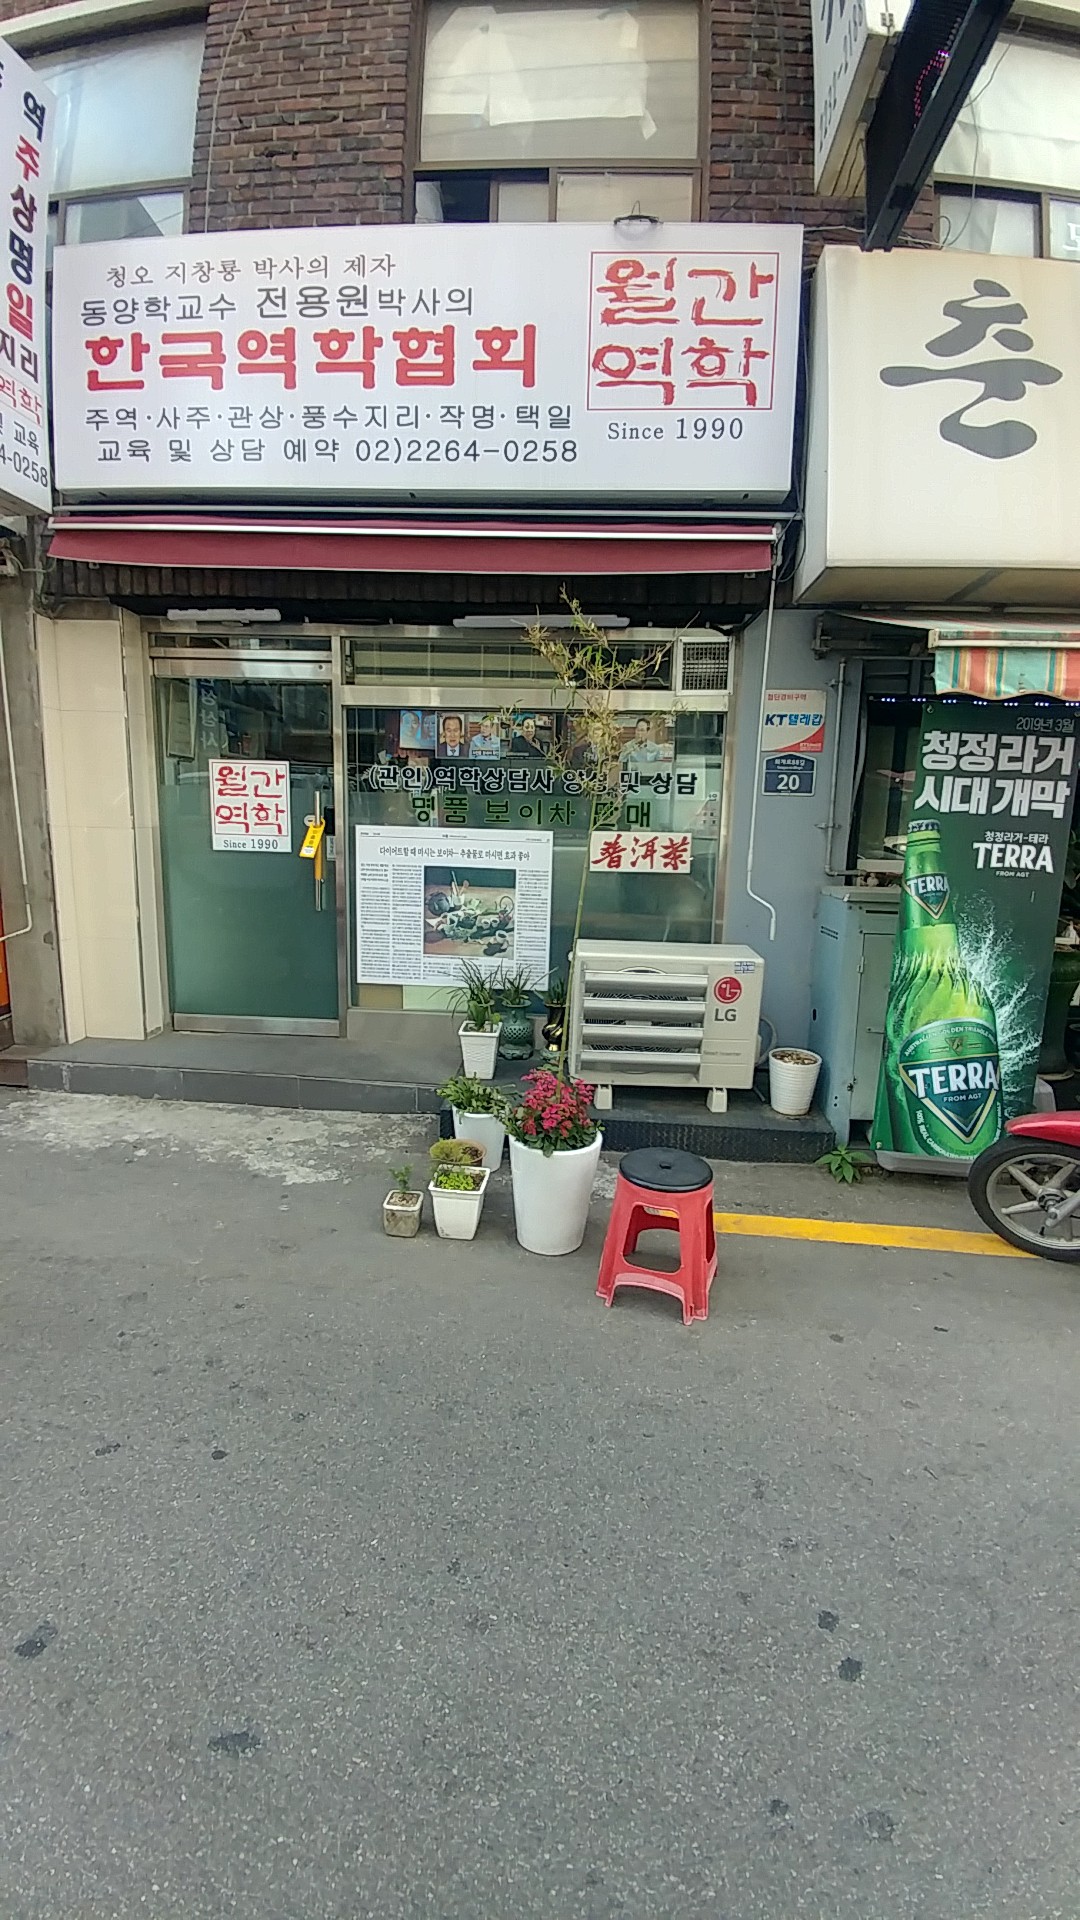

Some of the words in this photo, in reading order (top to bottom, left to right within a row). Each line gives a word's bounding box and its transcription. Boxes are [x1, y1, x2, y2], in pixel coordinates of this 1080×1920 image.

[106, 265, 154, 288] 청오
[165, 259, 242, 285] 지창룡
[253, 254, 329, 281] 박사의
[343, 253, 396, 278] 제자
[596, 257, 774, 326] 월간
[80, 294, 237, 326] 동양학교수
[85, 325, 537, 391] 한국역학협회
[592, 336, 771, 407] 역학
[879, 278, 1063, 460] 춘
[14, 421, 39, 457] 교육
[607, 422, 664, 440] Since
[675, 417, 744, 440] 1990
[97, 438, 152, 463] 교육
[169, 438, 192, 463] 및
[209, 438, 266, 463] 상담
[283, 438, 340, 463] 예약
[356, 438, 578, 463] 02)2264-0258
[1016, 717, 1053, 732] 2019년
[1055, 719, 1075, 733] 3월
[215, 765, 285, 799] 월간
[619, 771, 640, 795] 및
[650, 773, 698, 795] 상담
[777, 774, 800, 791] 20
[215, 803, 284, 834] 역학
[411, 797, 469, 824] 명품
[485, 799, 577, 826] 보이차
[223, 839, 247, 850] Since
[250, 838, 279, 850] 1990
[973, 842, 1053, 873] TERRA
[907, 876, 949, 897] TERRA
[714, 1008, 737, 1022] LG
[908, 1060, 999, 1099] TERRA
